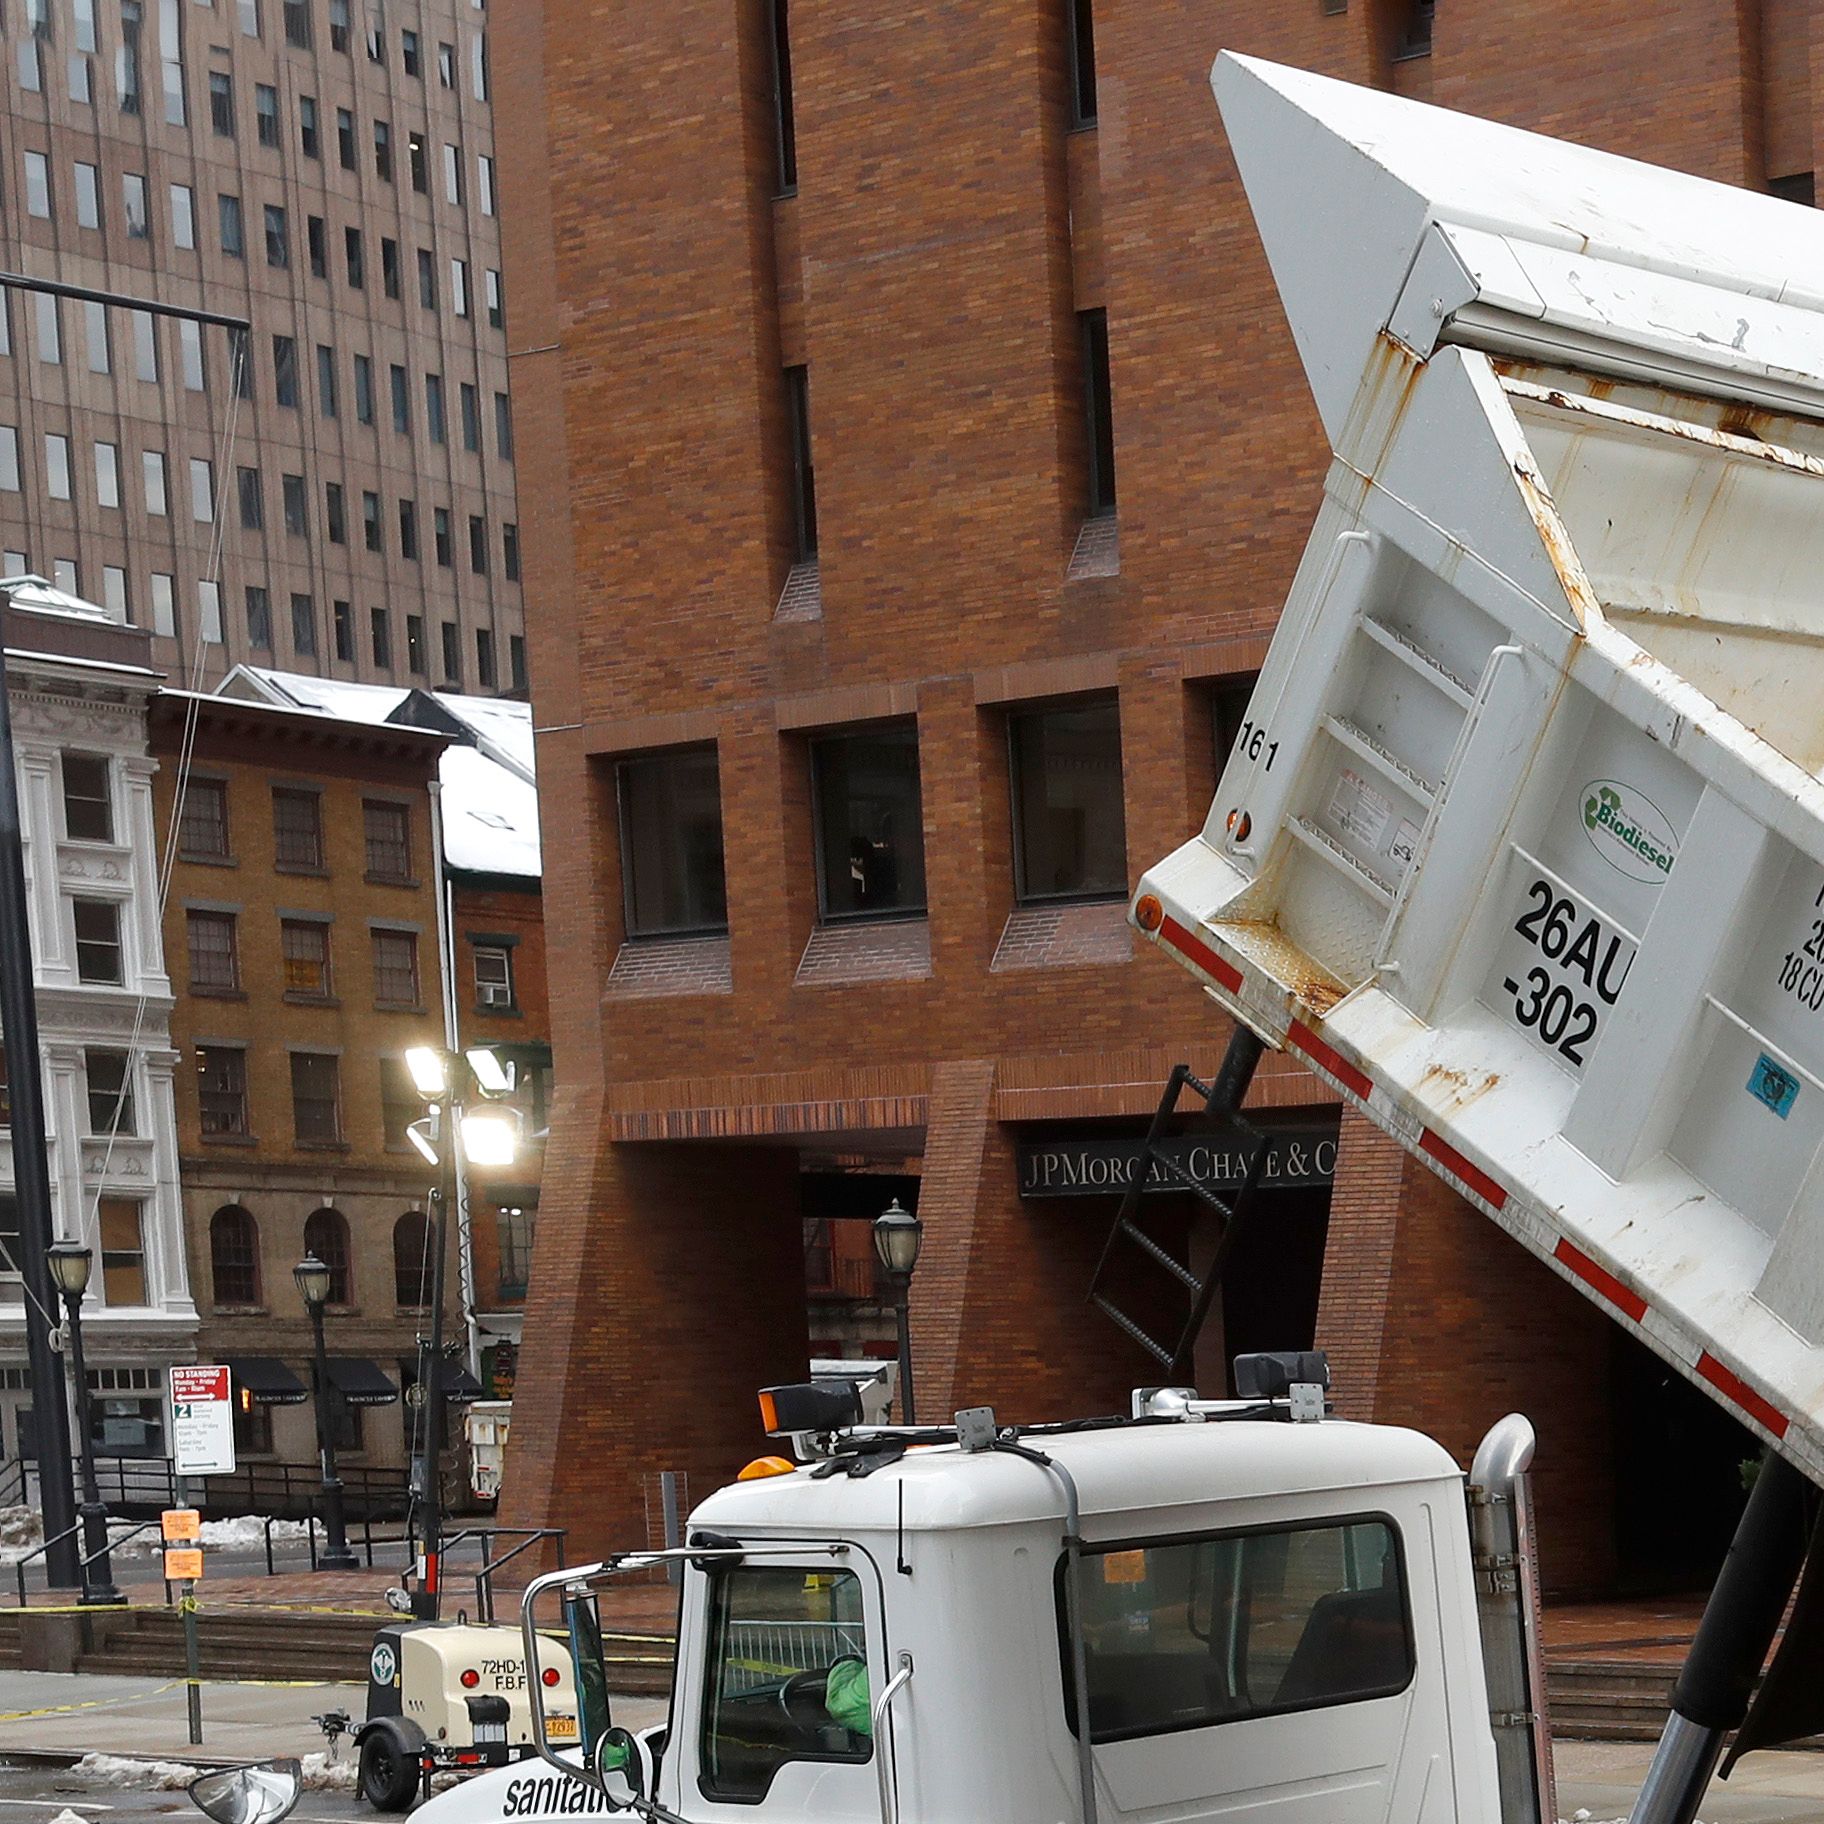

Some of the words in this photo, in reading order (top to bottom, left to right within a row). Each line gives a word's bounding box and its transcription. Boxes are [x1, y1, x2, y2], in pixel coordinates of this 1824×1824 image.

[1596, 802, 1675, 874] Biodiesel
[1514, 880, 1638, 1005] 26AU
[1778, 951, 1802, 994] 18
[1503, 966, 1598, 1067] -302
[1189, 1147, 1280, 1181] CHAE
[1286, 1142, 1311, 1176] &
[185, 1369, 220, 1378] STANDING
[179, 1404, 189, 1418] 2
[503, 1774, 643, 1818] sanitati
